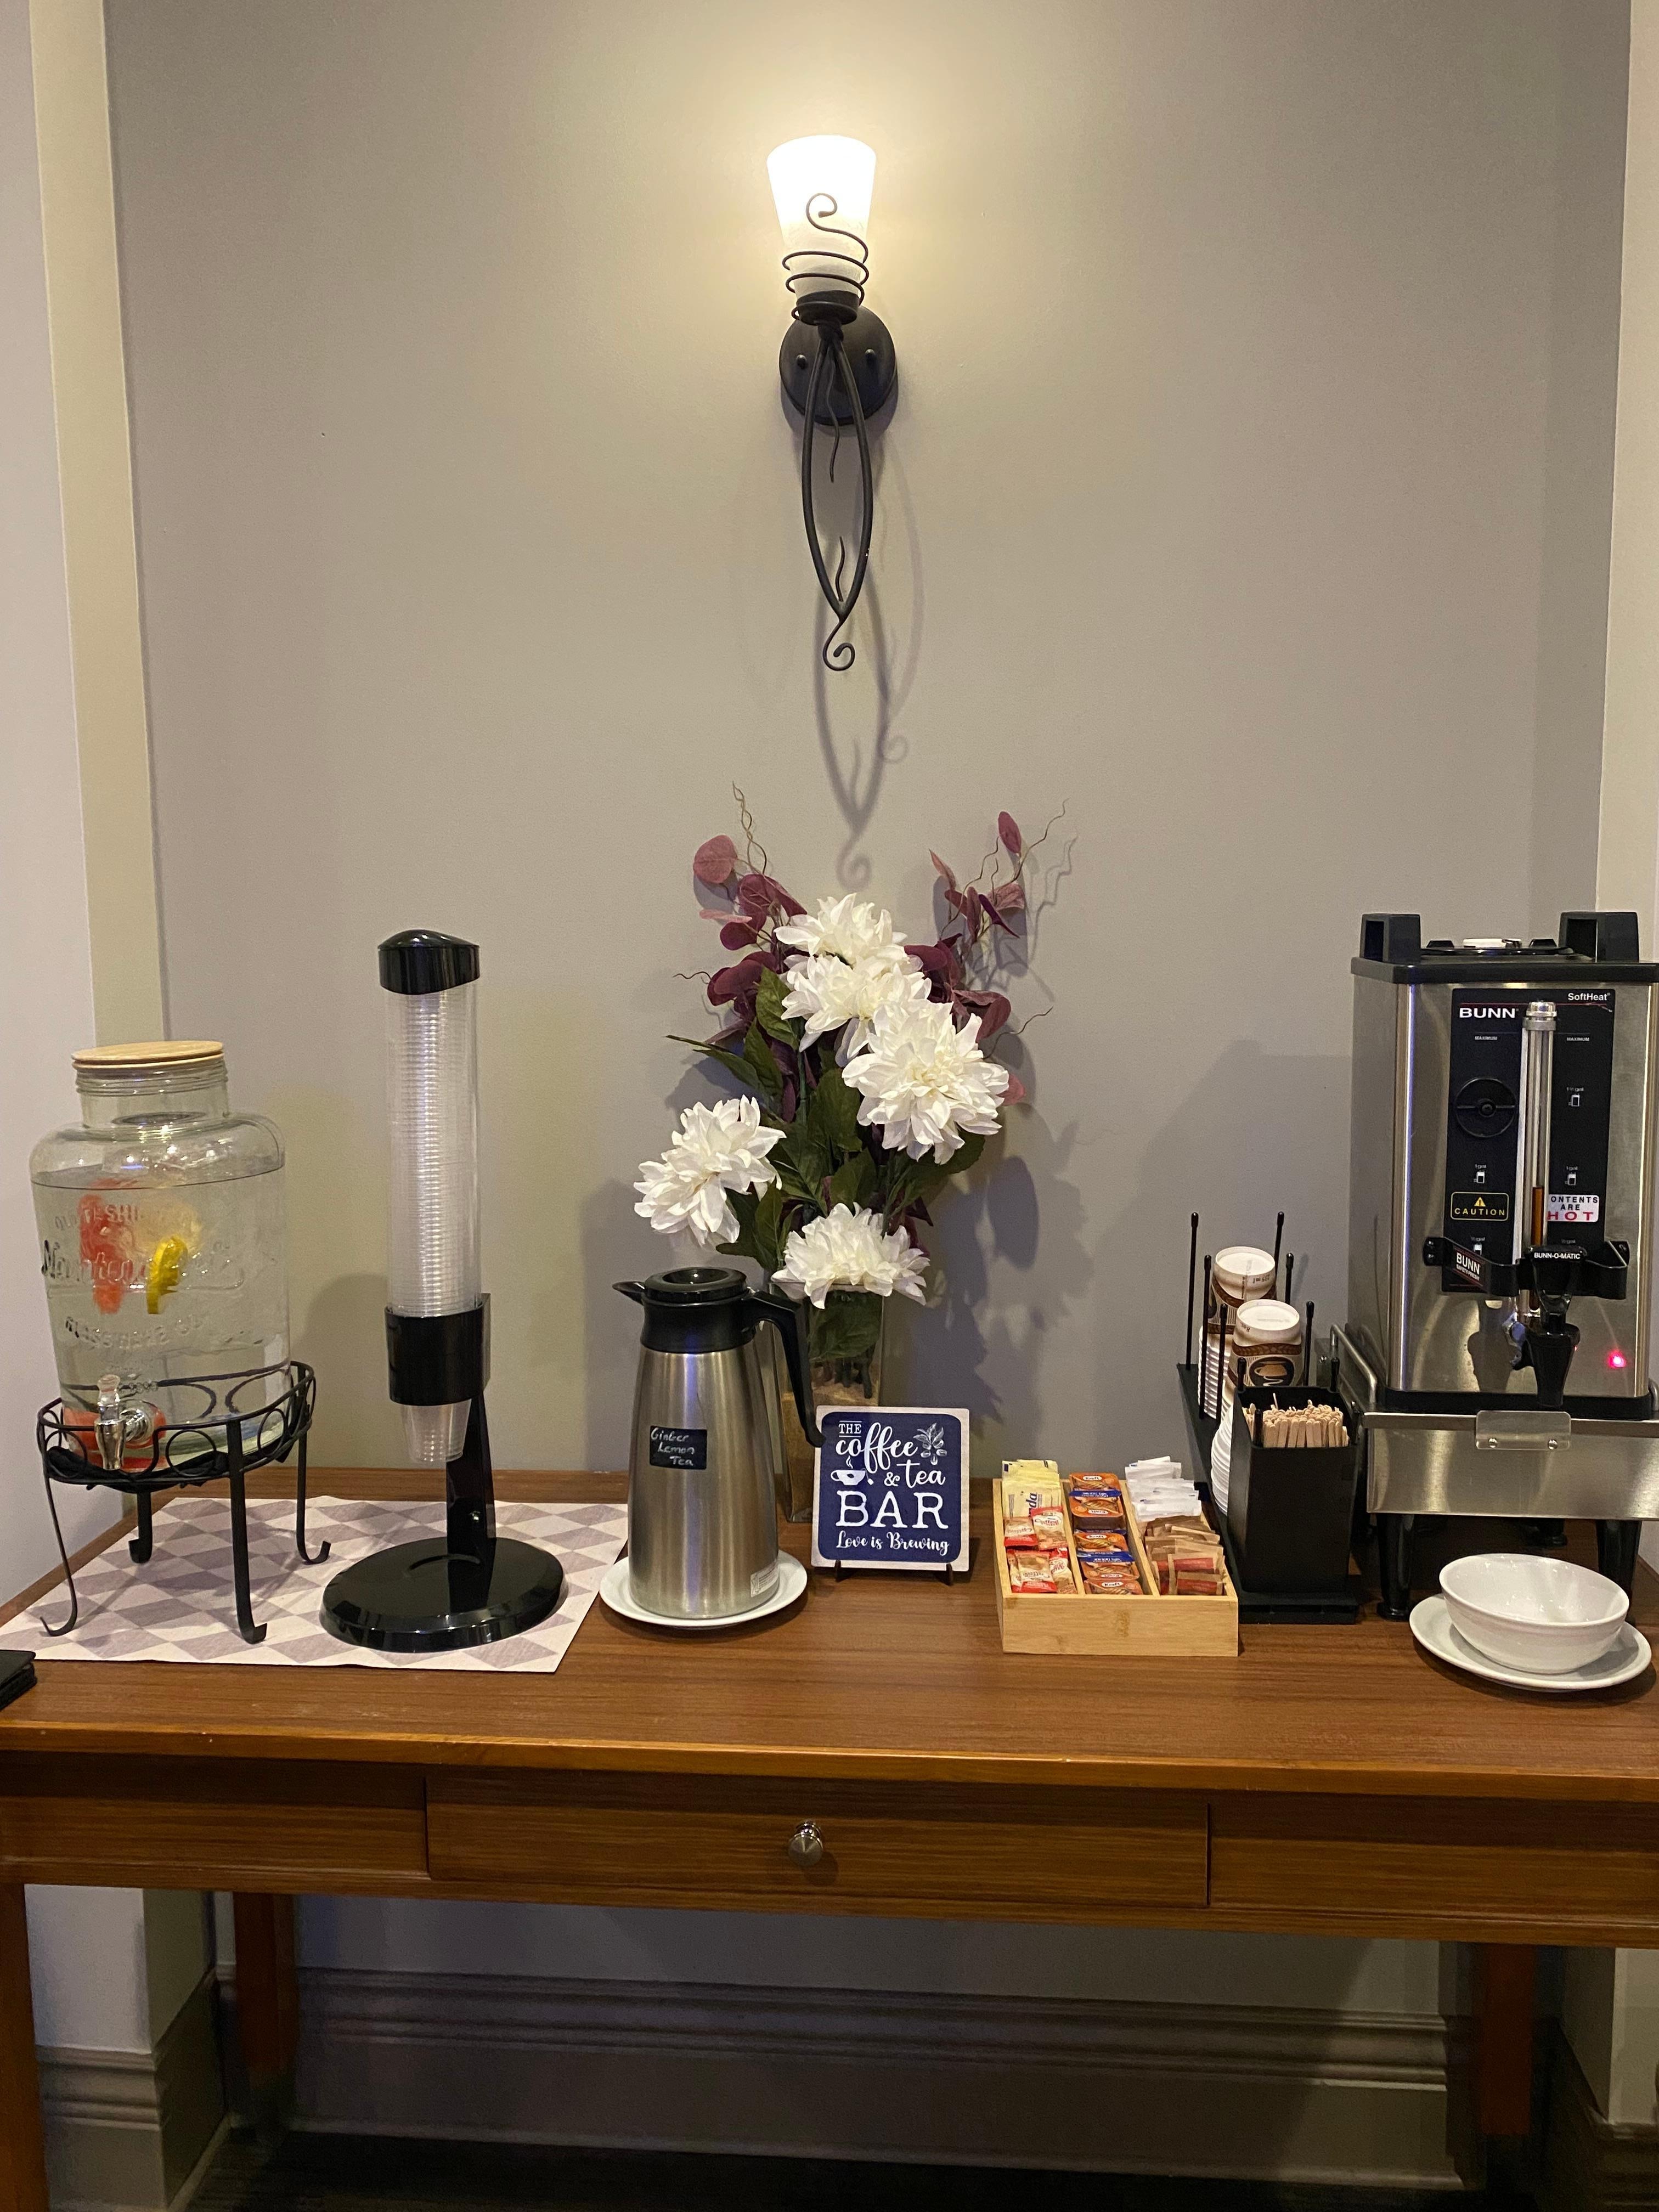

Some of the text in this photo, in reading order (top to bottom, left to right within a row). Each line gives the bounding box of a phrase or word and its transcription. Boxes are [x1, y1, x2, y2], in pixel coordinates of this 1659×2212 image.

[1568, 992, 1607, 1001] SoftHeat
[1459, 1008, 1516, 1018] BUNN
[1548, 1211, 1594, 1221] HOT
[1457, 1252, 1480, 1275] BUNN
[838, 1423, 861, 1435] THE
[836, 1422, 918, 1474] coffee
[669, 1455, 694, 1466] Tea
[884, 1459, 946, 1488] & tea
[835, 1490, 949, 1529] BAR
[836, 1530, 950, 1556] Love is Brewing
